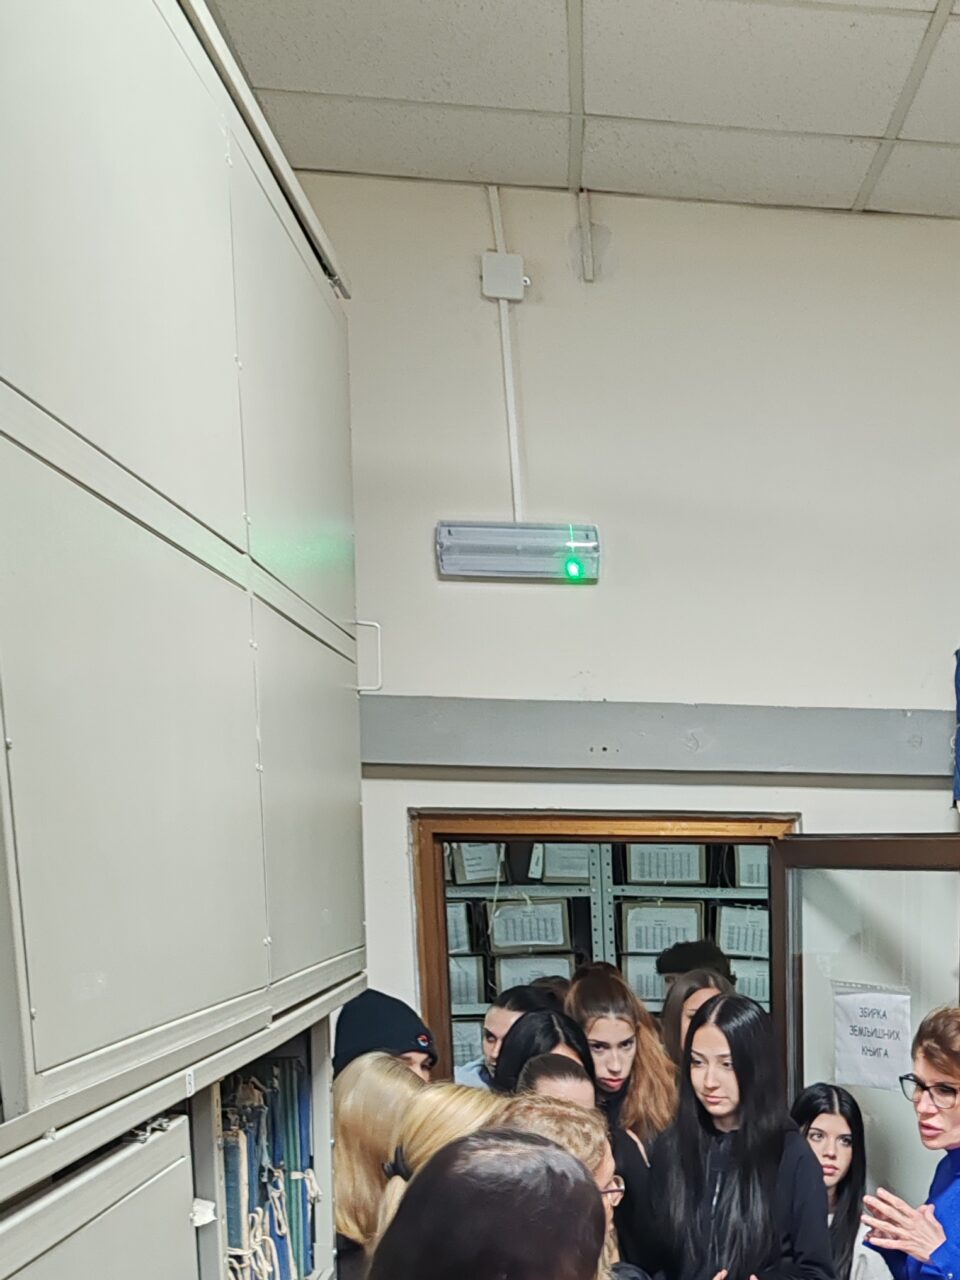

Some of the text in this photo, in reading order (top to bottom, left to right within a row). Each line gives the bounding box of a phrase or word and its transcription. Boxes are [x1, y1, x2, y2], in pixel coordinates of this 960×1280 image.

[858, 1007, 887, 1020] ЗБИРКА
[848, 1024, 901, 1041] ЗЕМЉИШНИХ
[861, 1046, 889, 1059] КЊИГА
